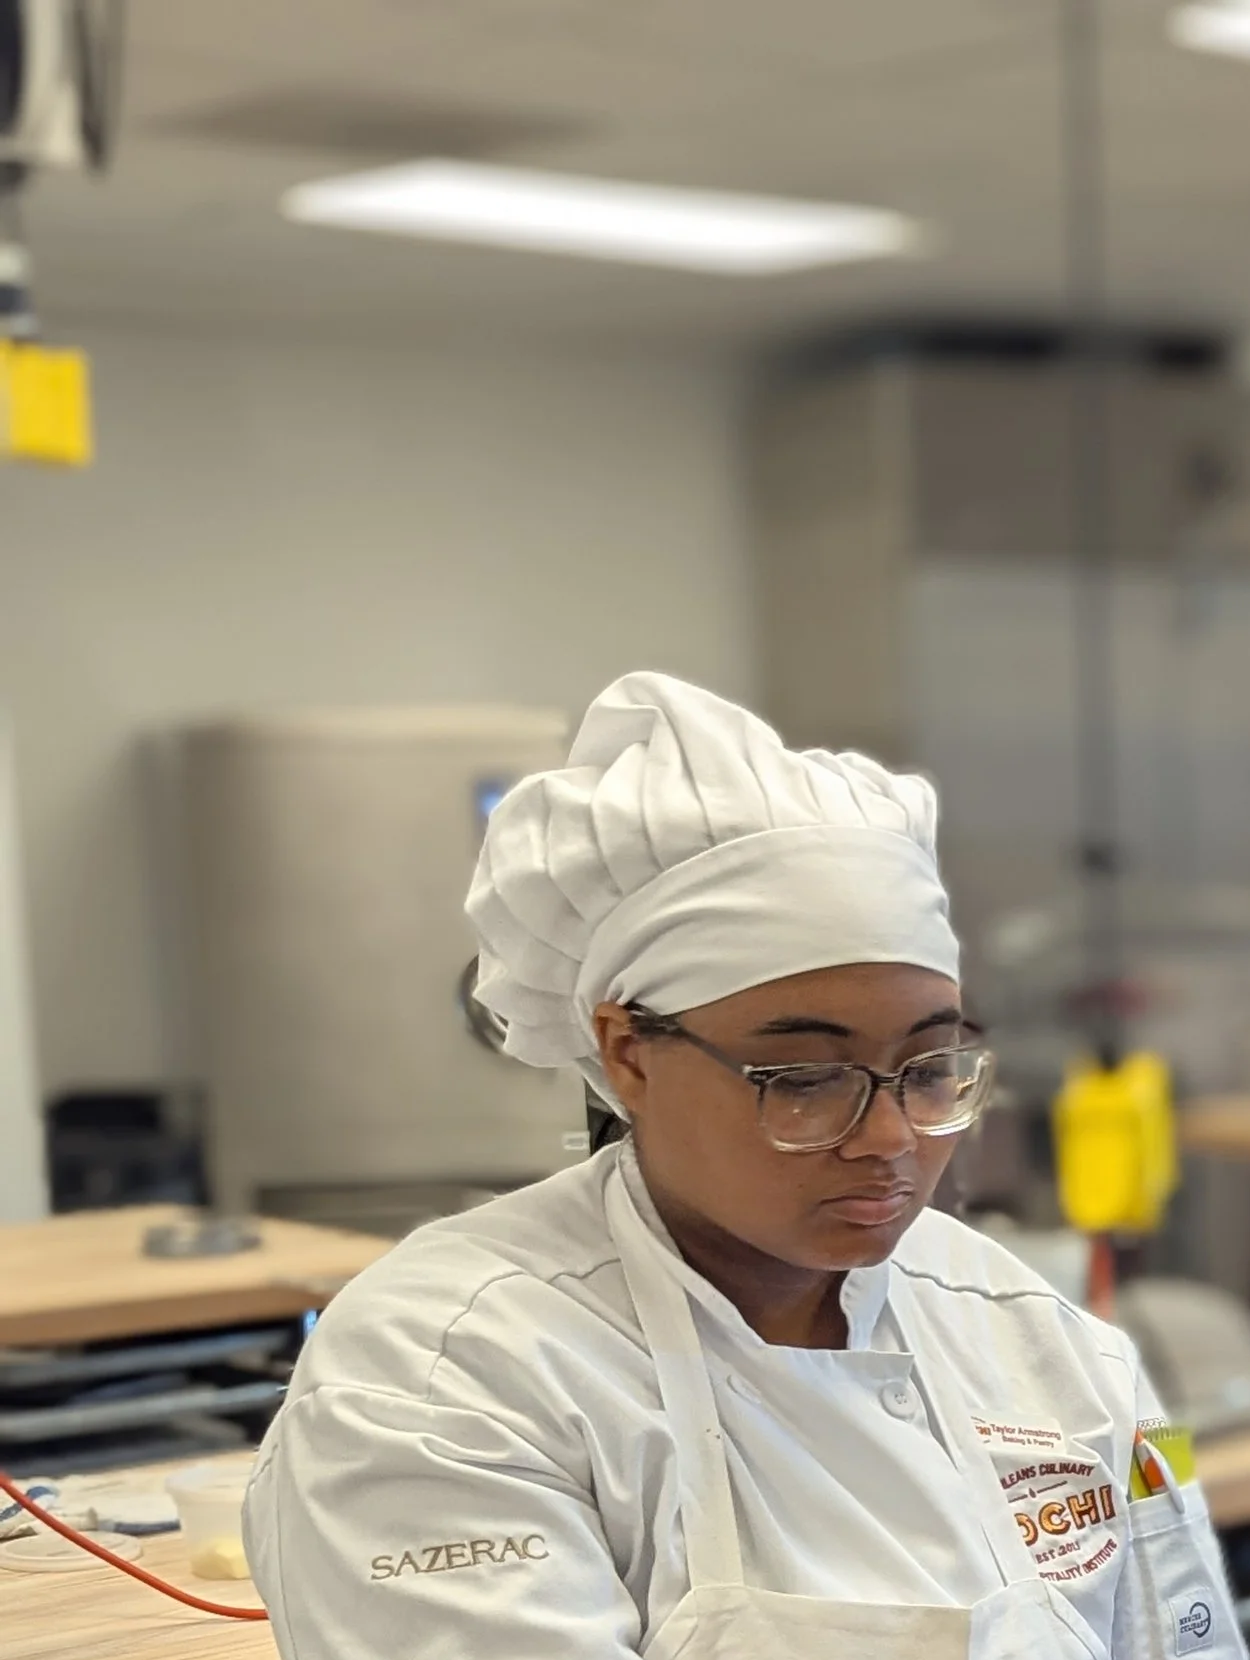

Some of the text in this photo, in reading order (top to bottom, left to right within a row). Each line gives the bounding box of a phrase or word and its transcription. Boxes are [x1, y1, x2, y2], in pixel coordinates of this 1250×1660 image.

[990, 1424, 1016, 1436] Taylor
[1018, 1427, 1061, 1440] Armstrong
[1039, 1463, 1095, 1477] CULINARY
[371, 1534, 549, 1580] SAZERAC
